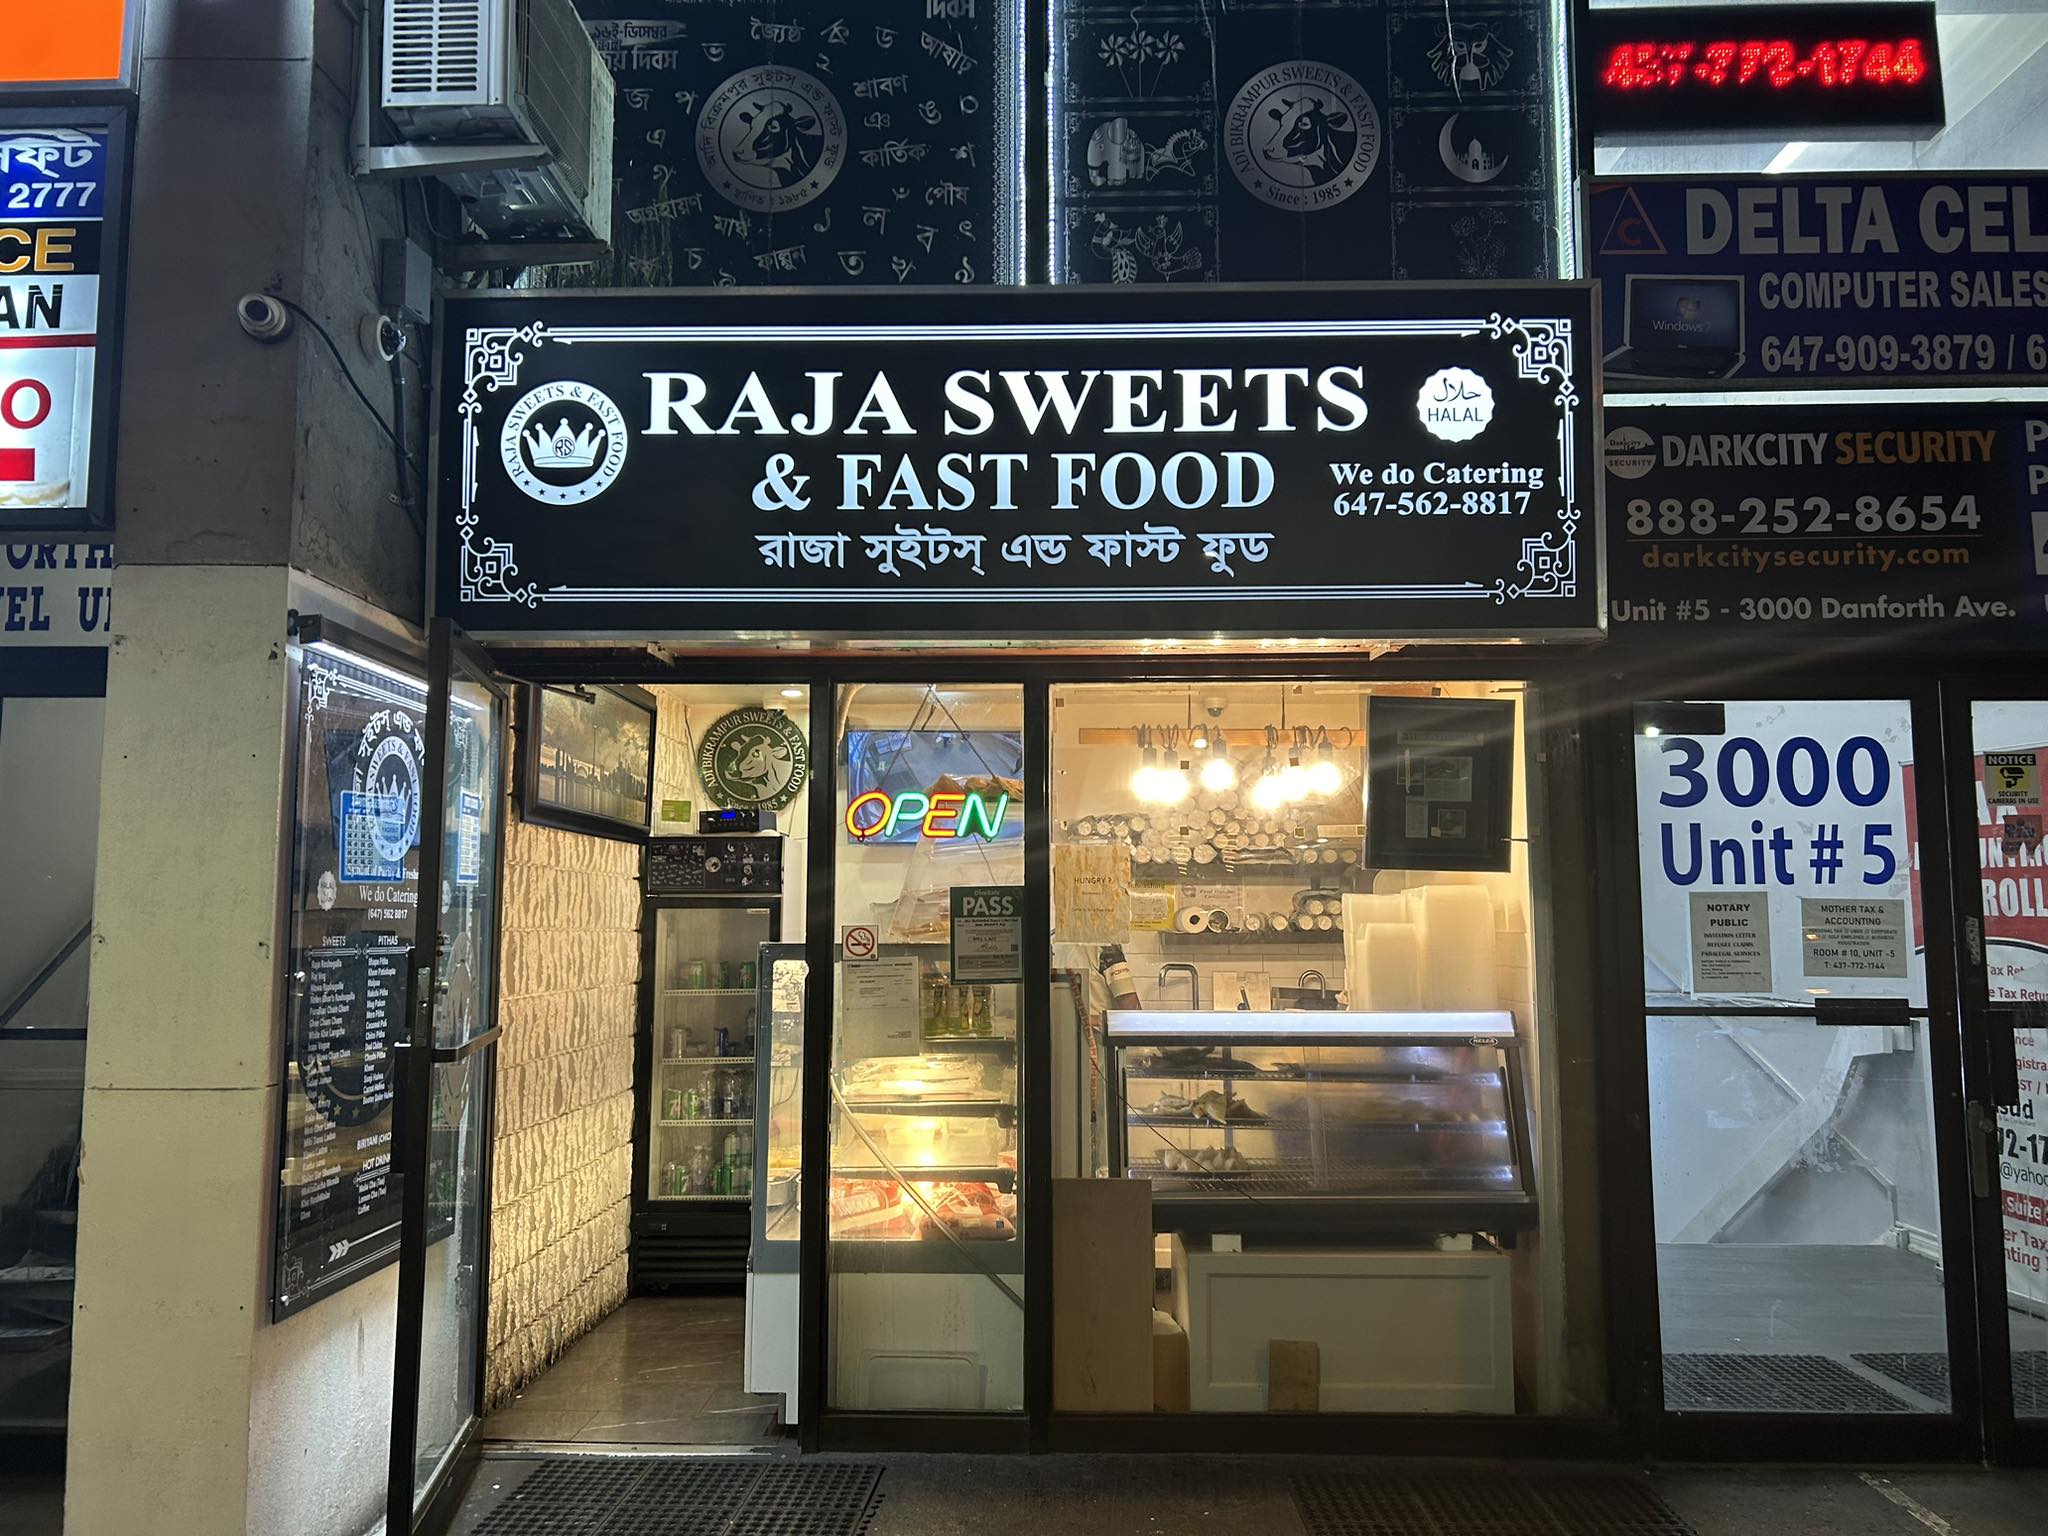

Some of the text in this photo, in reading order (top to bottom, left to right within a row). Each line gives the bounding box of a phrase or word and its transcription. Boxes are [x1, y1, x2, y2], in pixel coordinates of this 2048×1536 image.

[1281, 65, 1341, 89] SWEETS
[1230, 72, 1281, 147] BIKRAMPUR
[1351, 94, 1377, 132] FAST
[1354, 133, 1377, 174] FOOD
[7, 181, 97, 208] 2777
[1265, 184, 1342, 206] Since 1985
[1684, 185, 1900, 256] DELTA
[1758, 271, 1942, 311] COMPUTER
[1652, 319, 1704, 334] Windows
[1761, 334, 1996, 373] 647-909-3879
[640, 365, 1370, 437] RAJA SWEETS
[1433, 379, 1482, 403] حلال
[1427, 407, 1484, 424] HALAL
[504, 384, 623, 478] RAJA SWEETS & FAST FOOD
[1661, 429, 1998, 468] DARKCITY SECURITY
[1329, 461, 1545, 488] We do Catering
[1608, 459, 1653, 468] SECURITY
[751, 450, 1276, 511] & FAST FOOD
[1333, 490, 1532, 517] 647-562-8817
[1625, 493, 1982, 537] 888-252-8654
[754, 532, 852, 569] রাজা
[864, 523, 988, 577] সুইটস্
[1083, 521, 1187, 569] ফাস্ট
[1196, 531, 1275, 577] ফুড
[1640, 541, 1970, 574] darkcitysecurity.com
[1611, 599, 1668, 622] Unit
[1675, 597, 1711, 621] #5
[1739, 595, 1813, 620] 3000
[1821, 594, 1946, 620] Danforth
[1953, 593, 2017, 618] Ave.
[742, 710, 784, 730] SWEETS
[702, 713, 742, 767] BIKRAMPUR
[789, 733, 806, 762] FAST
[1659, 735, 1891, 808] 3000
[1987, 753, 2036, 766] NOTICE
[787, 762, 807, 793] FOOD
[1998, 790, 2029, 798] SECURITY
[845, 790, 1009, 840] OPEN
[1660, 819, 1897, 886] Unit # 5
[1074, 877, 1105, 886] HUNGRY
[359, 884, 373, 902] We
[374, 886, 385, 902] do
[386, 886, 419, 908] Catering
[962, 895, 1015, 917] PASS
[1707, 903, 1751, 912] NOTARY
[1820, 904, 1885, 914] MOTHER TAX &
[367, 908, 383, 921] (647)
[383, 908, 394, 920] 562
[1710, 918, 1749, 927] PUBLIC
[1824, 916, 1882, 926] ACCOUNTING
[321, 935, 347, 947] SWEETS
[377, 934, 399, 946] PITHAS
[1813, 948, 1839, 957] ROOM
[1841, 949, 1848, 957] #
[1862, 949, 1883, 958] UNIT
[1997, 986, 2017, 999] Tax
[362, 1158, 376, 1172] HOT
